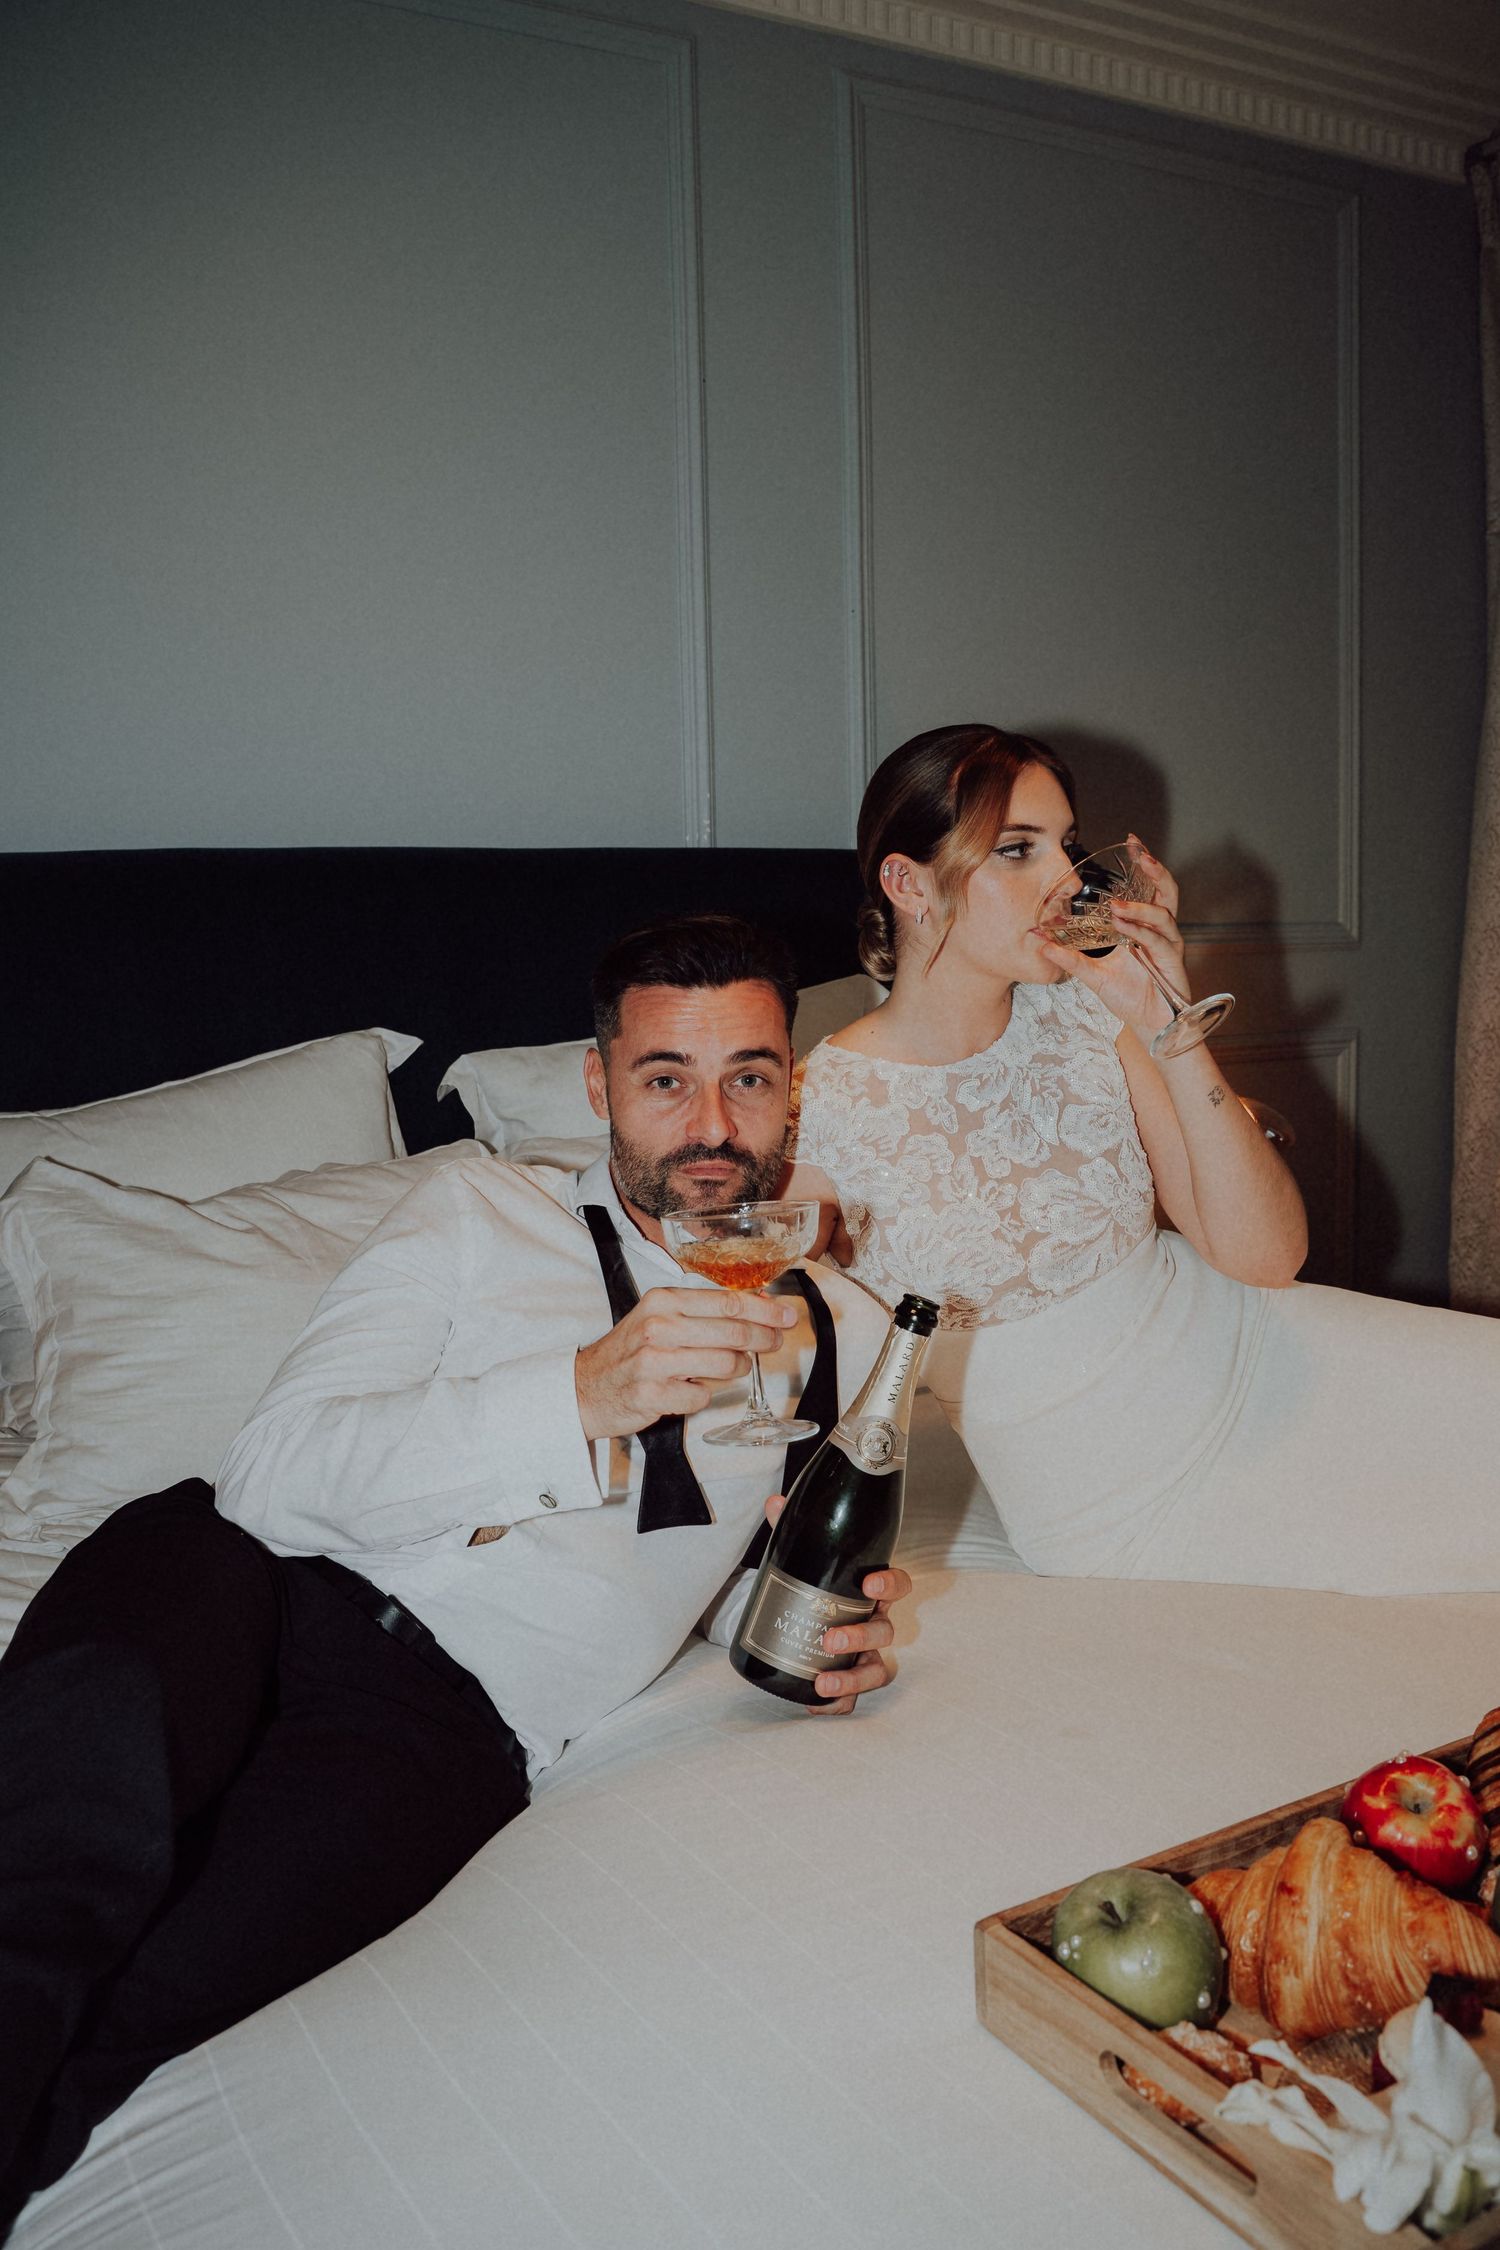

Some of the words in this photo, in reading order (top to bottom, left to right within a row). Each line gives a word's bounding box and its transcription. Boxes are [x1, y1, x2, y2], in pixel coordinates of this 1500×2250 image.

[887, 1341, 915, 1404] MALARD
[774, 1617, 823, 1646] MALA
[784, 1610, 831, 1632] CHAMPA
[805, 1646, 835, 1659] PREMIUM
